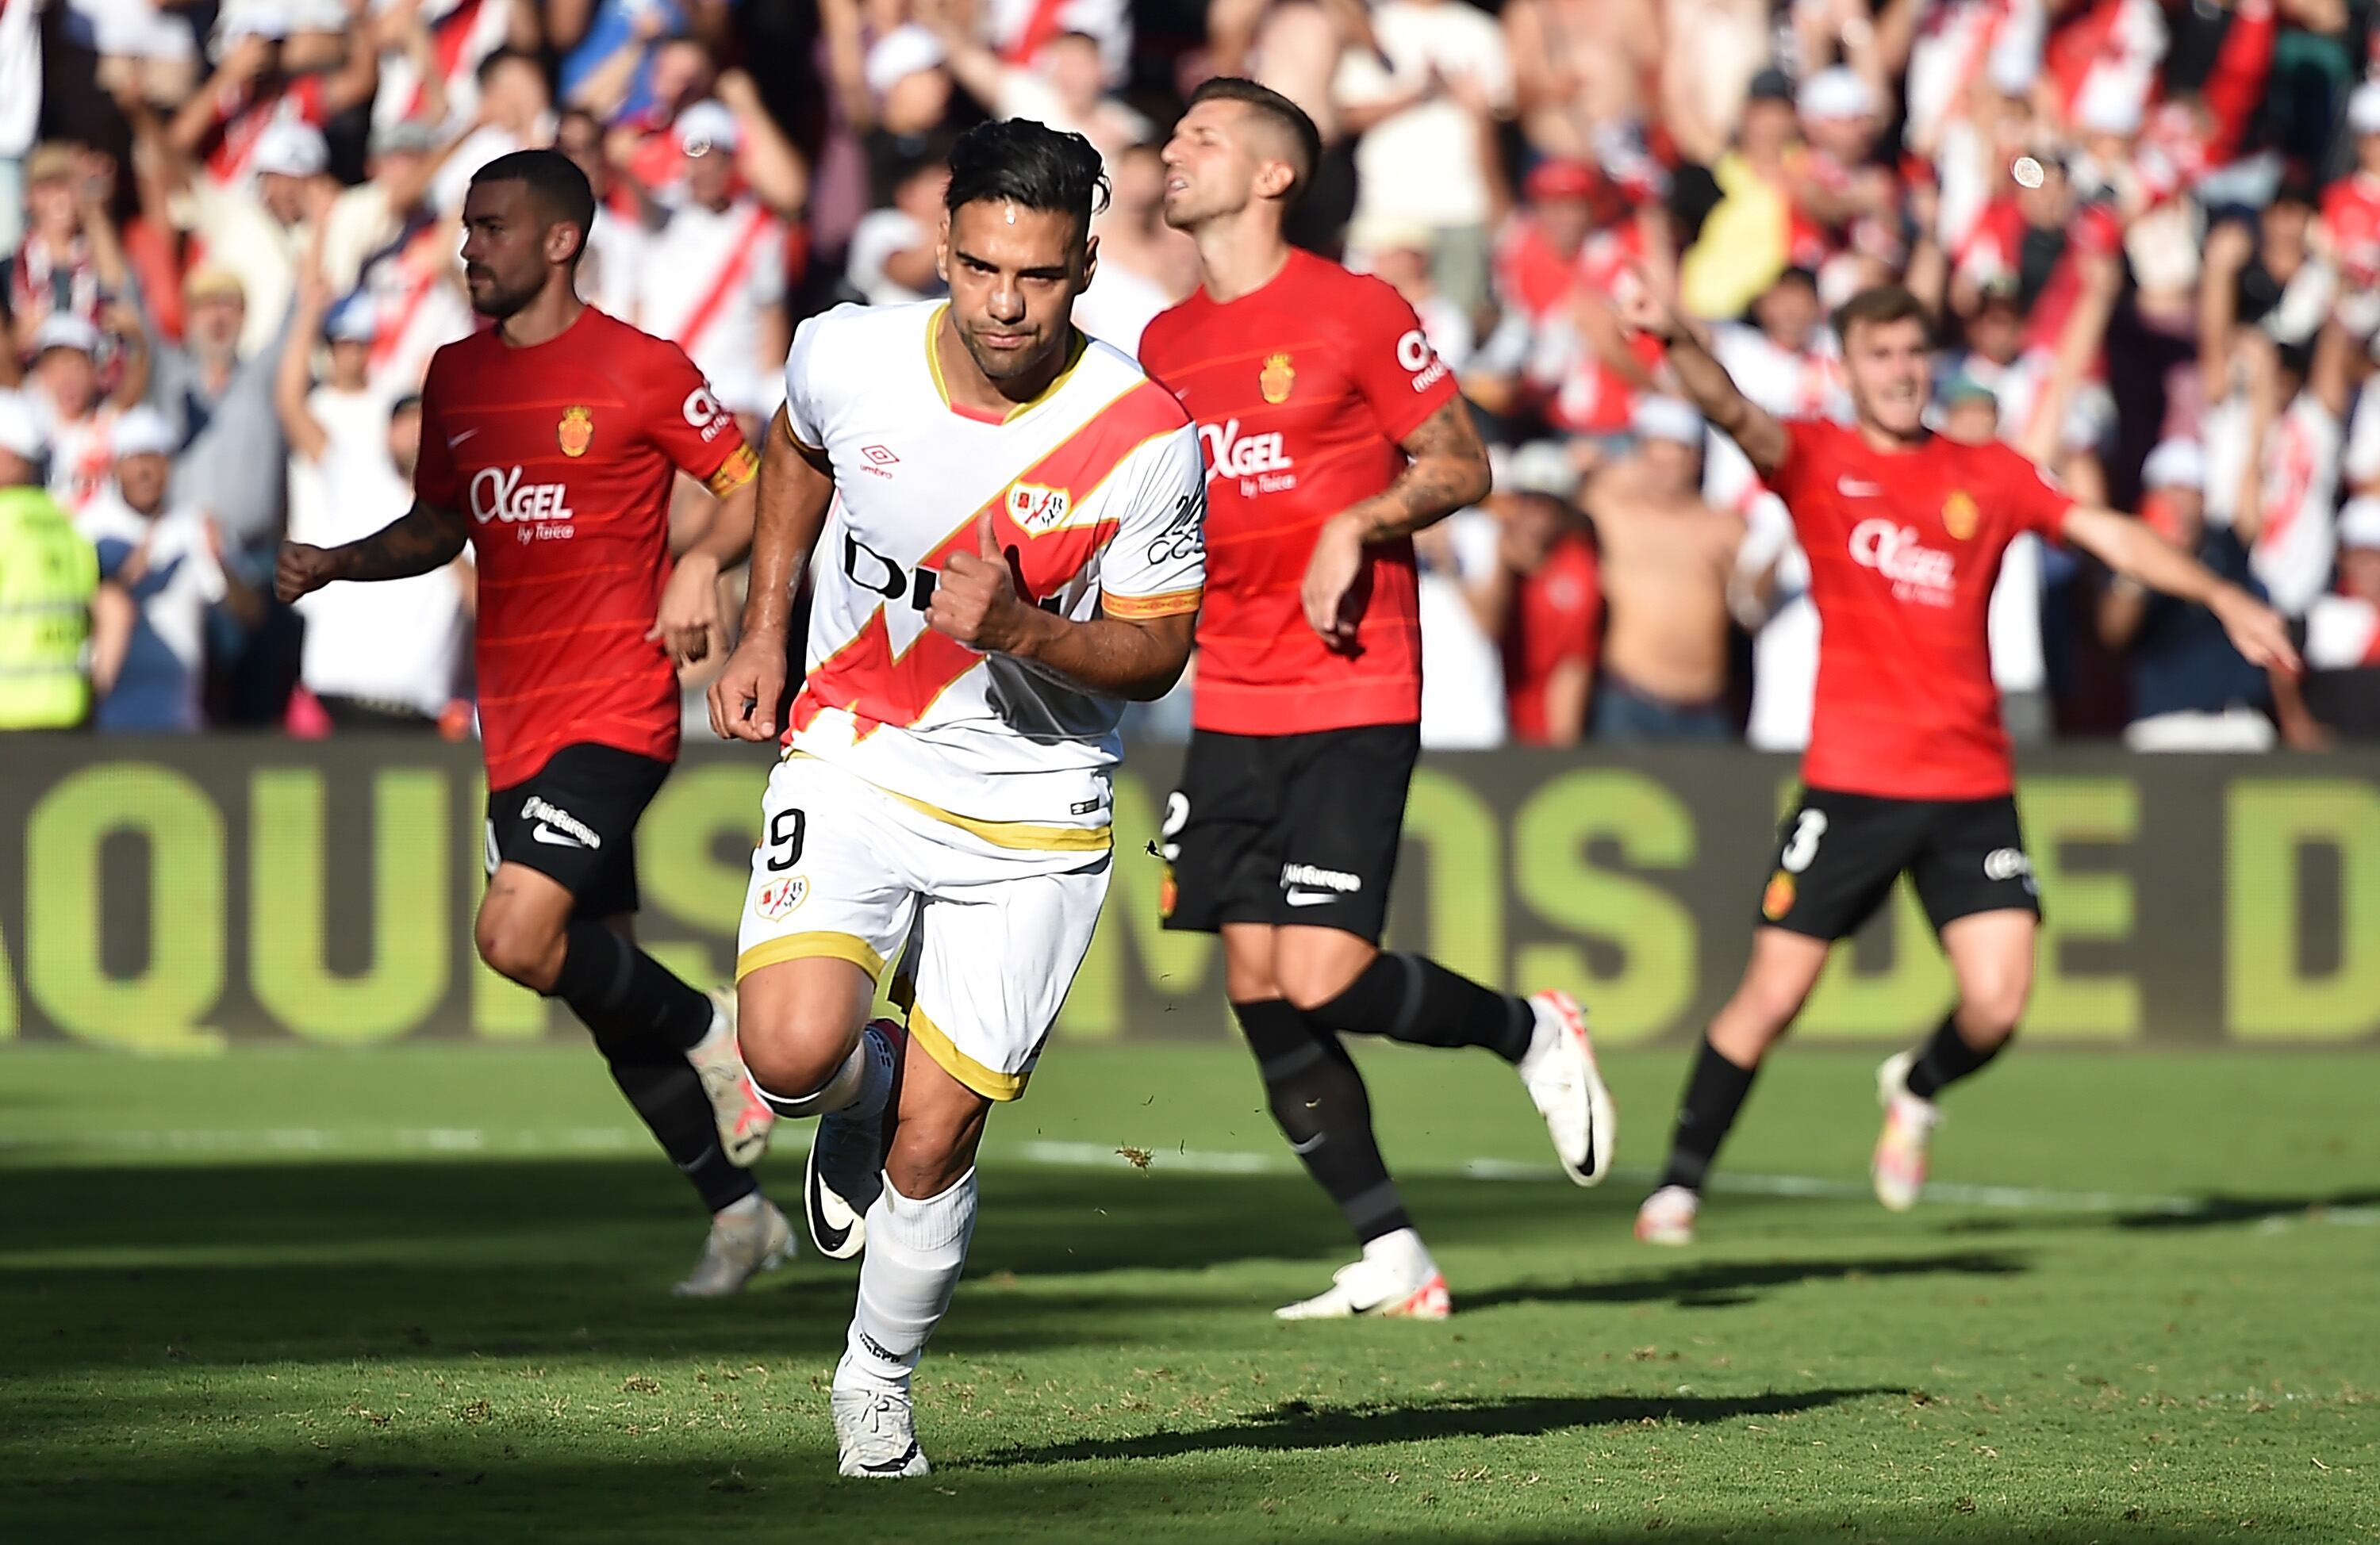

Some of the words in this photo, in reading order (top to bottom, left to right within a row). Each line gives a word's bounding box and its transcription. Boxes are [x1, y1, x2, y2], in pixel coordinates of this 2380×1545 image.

[859, 464, 893, 480] umbro
[766, 807, 806, 872] 9
[1781, 807, 1829, 873] 3
